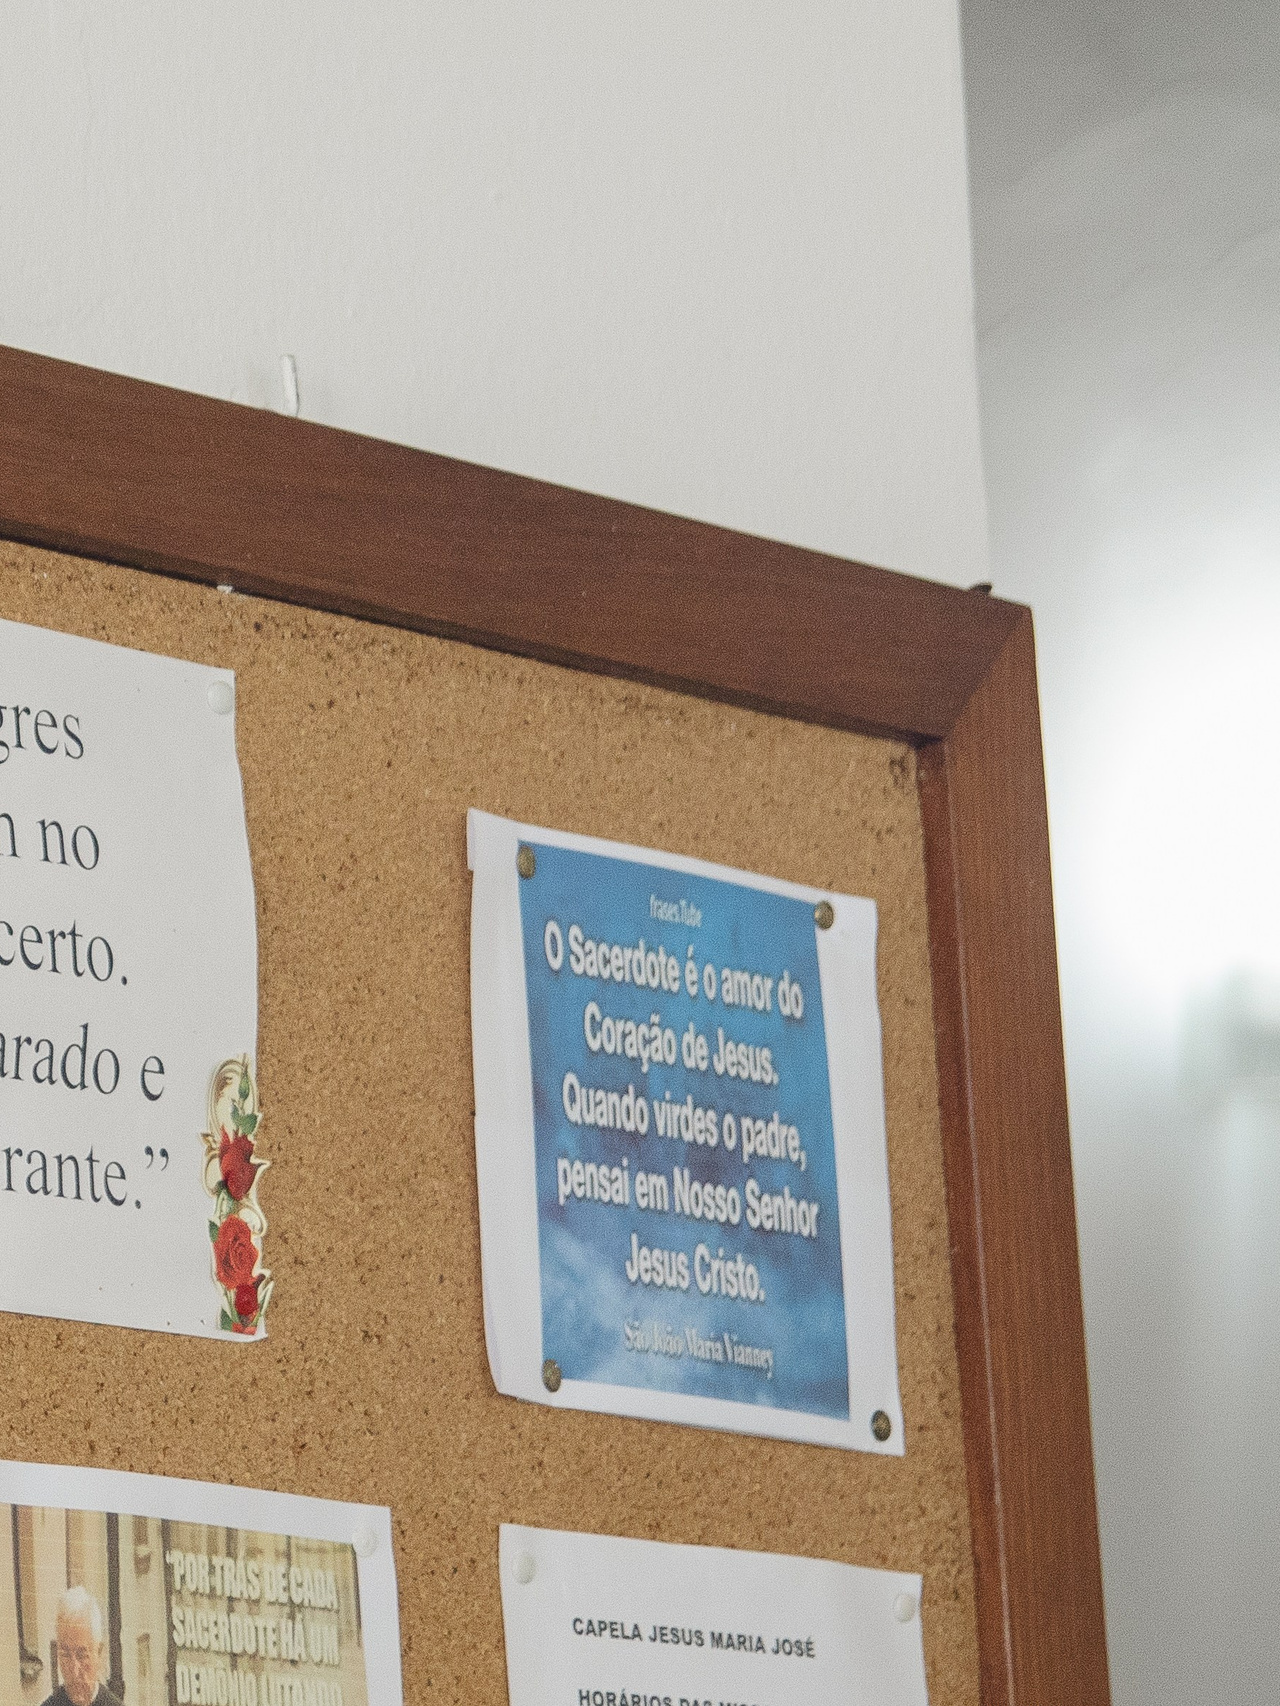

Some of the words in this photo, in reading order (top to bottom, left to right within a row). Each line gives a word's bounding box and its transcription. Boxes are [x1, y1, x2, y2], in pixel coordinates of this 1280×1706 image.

[36, 817, 101, 871] no
[544, 919, 564, 971] O
[568, 924, 680, 994] Sacerdote
[684, 944, 699, 998] é
[703, 962, 718, 1001] o
[721, 967, 774, 1012] amor
[778, 969, 804, 1019] do
[583, 1001, 677, 1075] Coração
[681, 1021, 709, 1072] de
[712, 1026, 780, 1086] Jesus.
[139, 1052, 166, 1102] e
[562, 1070, 650, 1136] Quando
[653, 1091, 718, 1148] virdes
[722, 1112, 737, 1151] o
[740, 1111, 807, 1172] padre,
[556, 1156, 630, 1206] pensai
[634, 1170, 669, 1212] em
[672, 1165, 741, 1225] Nosso
[744, 1178, 819, 1239] Senhor
[624, 1232, 690, 1291] Jesus
[694, 1242, 766, 1302] Cristo.
[264, 1562, 289, 1604] DE
[172, 1605, 279, 1659] SACERDOTE
[309, 1622, 340, 1666] UM
[572, 1617, 644, 1641] CAPELA
[648, 1625, 705, 1647] JESUS
[710, 1631, 767, 1654] MARIA
[771, 1637, 817, 1659] JOSÉ
